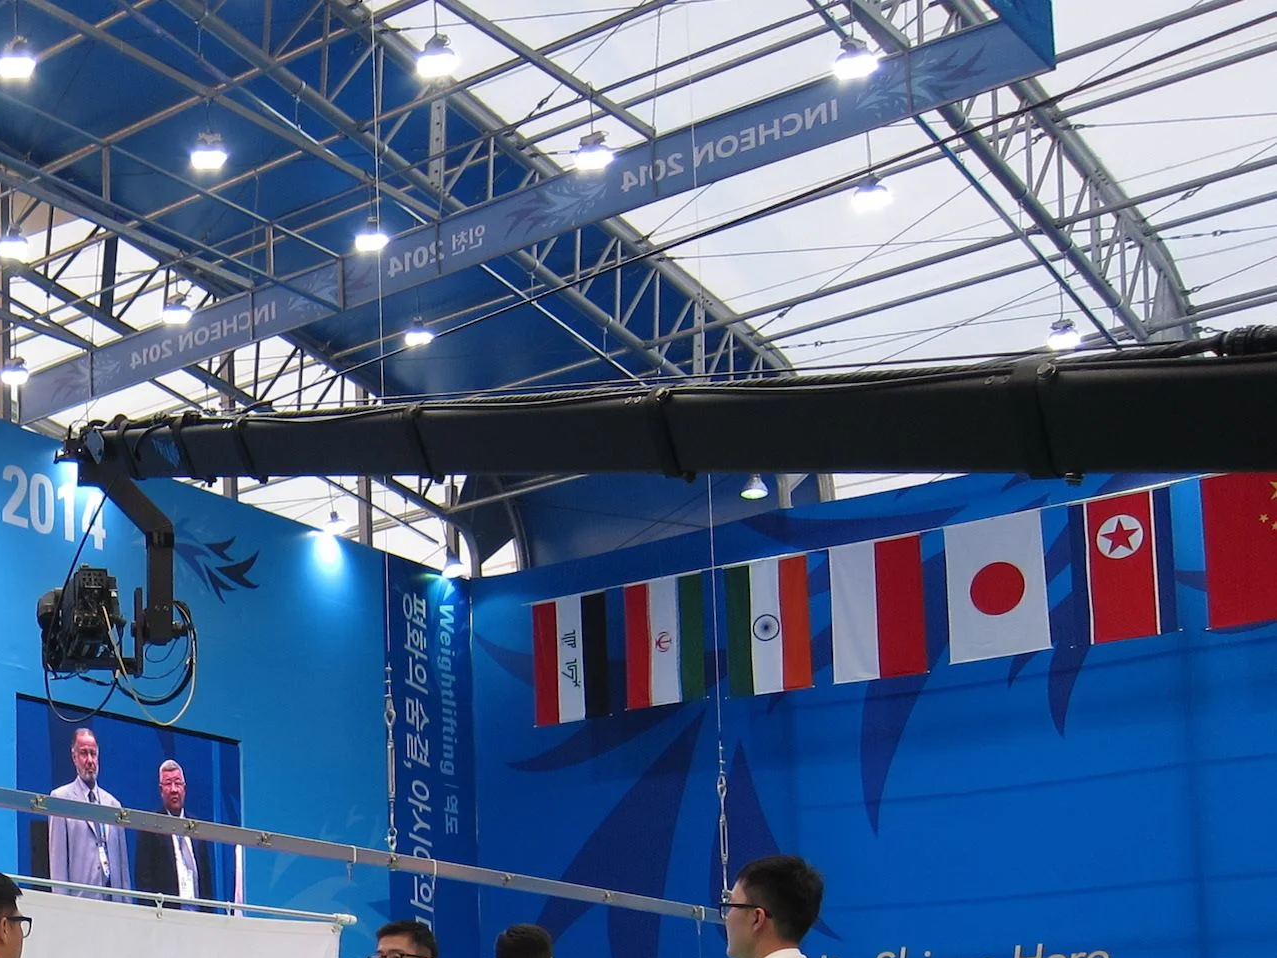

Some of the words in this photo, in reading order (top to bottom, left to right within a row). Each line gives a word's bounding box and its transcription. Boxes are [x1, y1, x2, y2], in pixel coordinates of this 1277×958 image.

[2, 464, 107, 551] 2014
[403, 593, 429, 696] 평화의
[439, 603, 459, 776] Weightlifting
[444, 793, 459, 834] 역도
